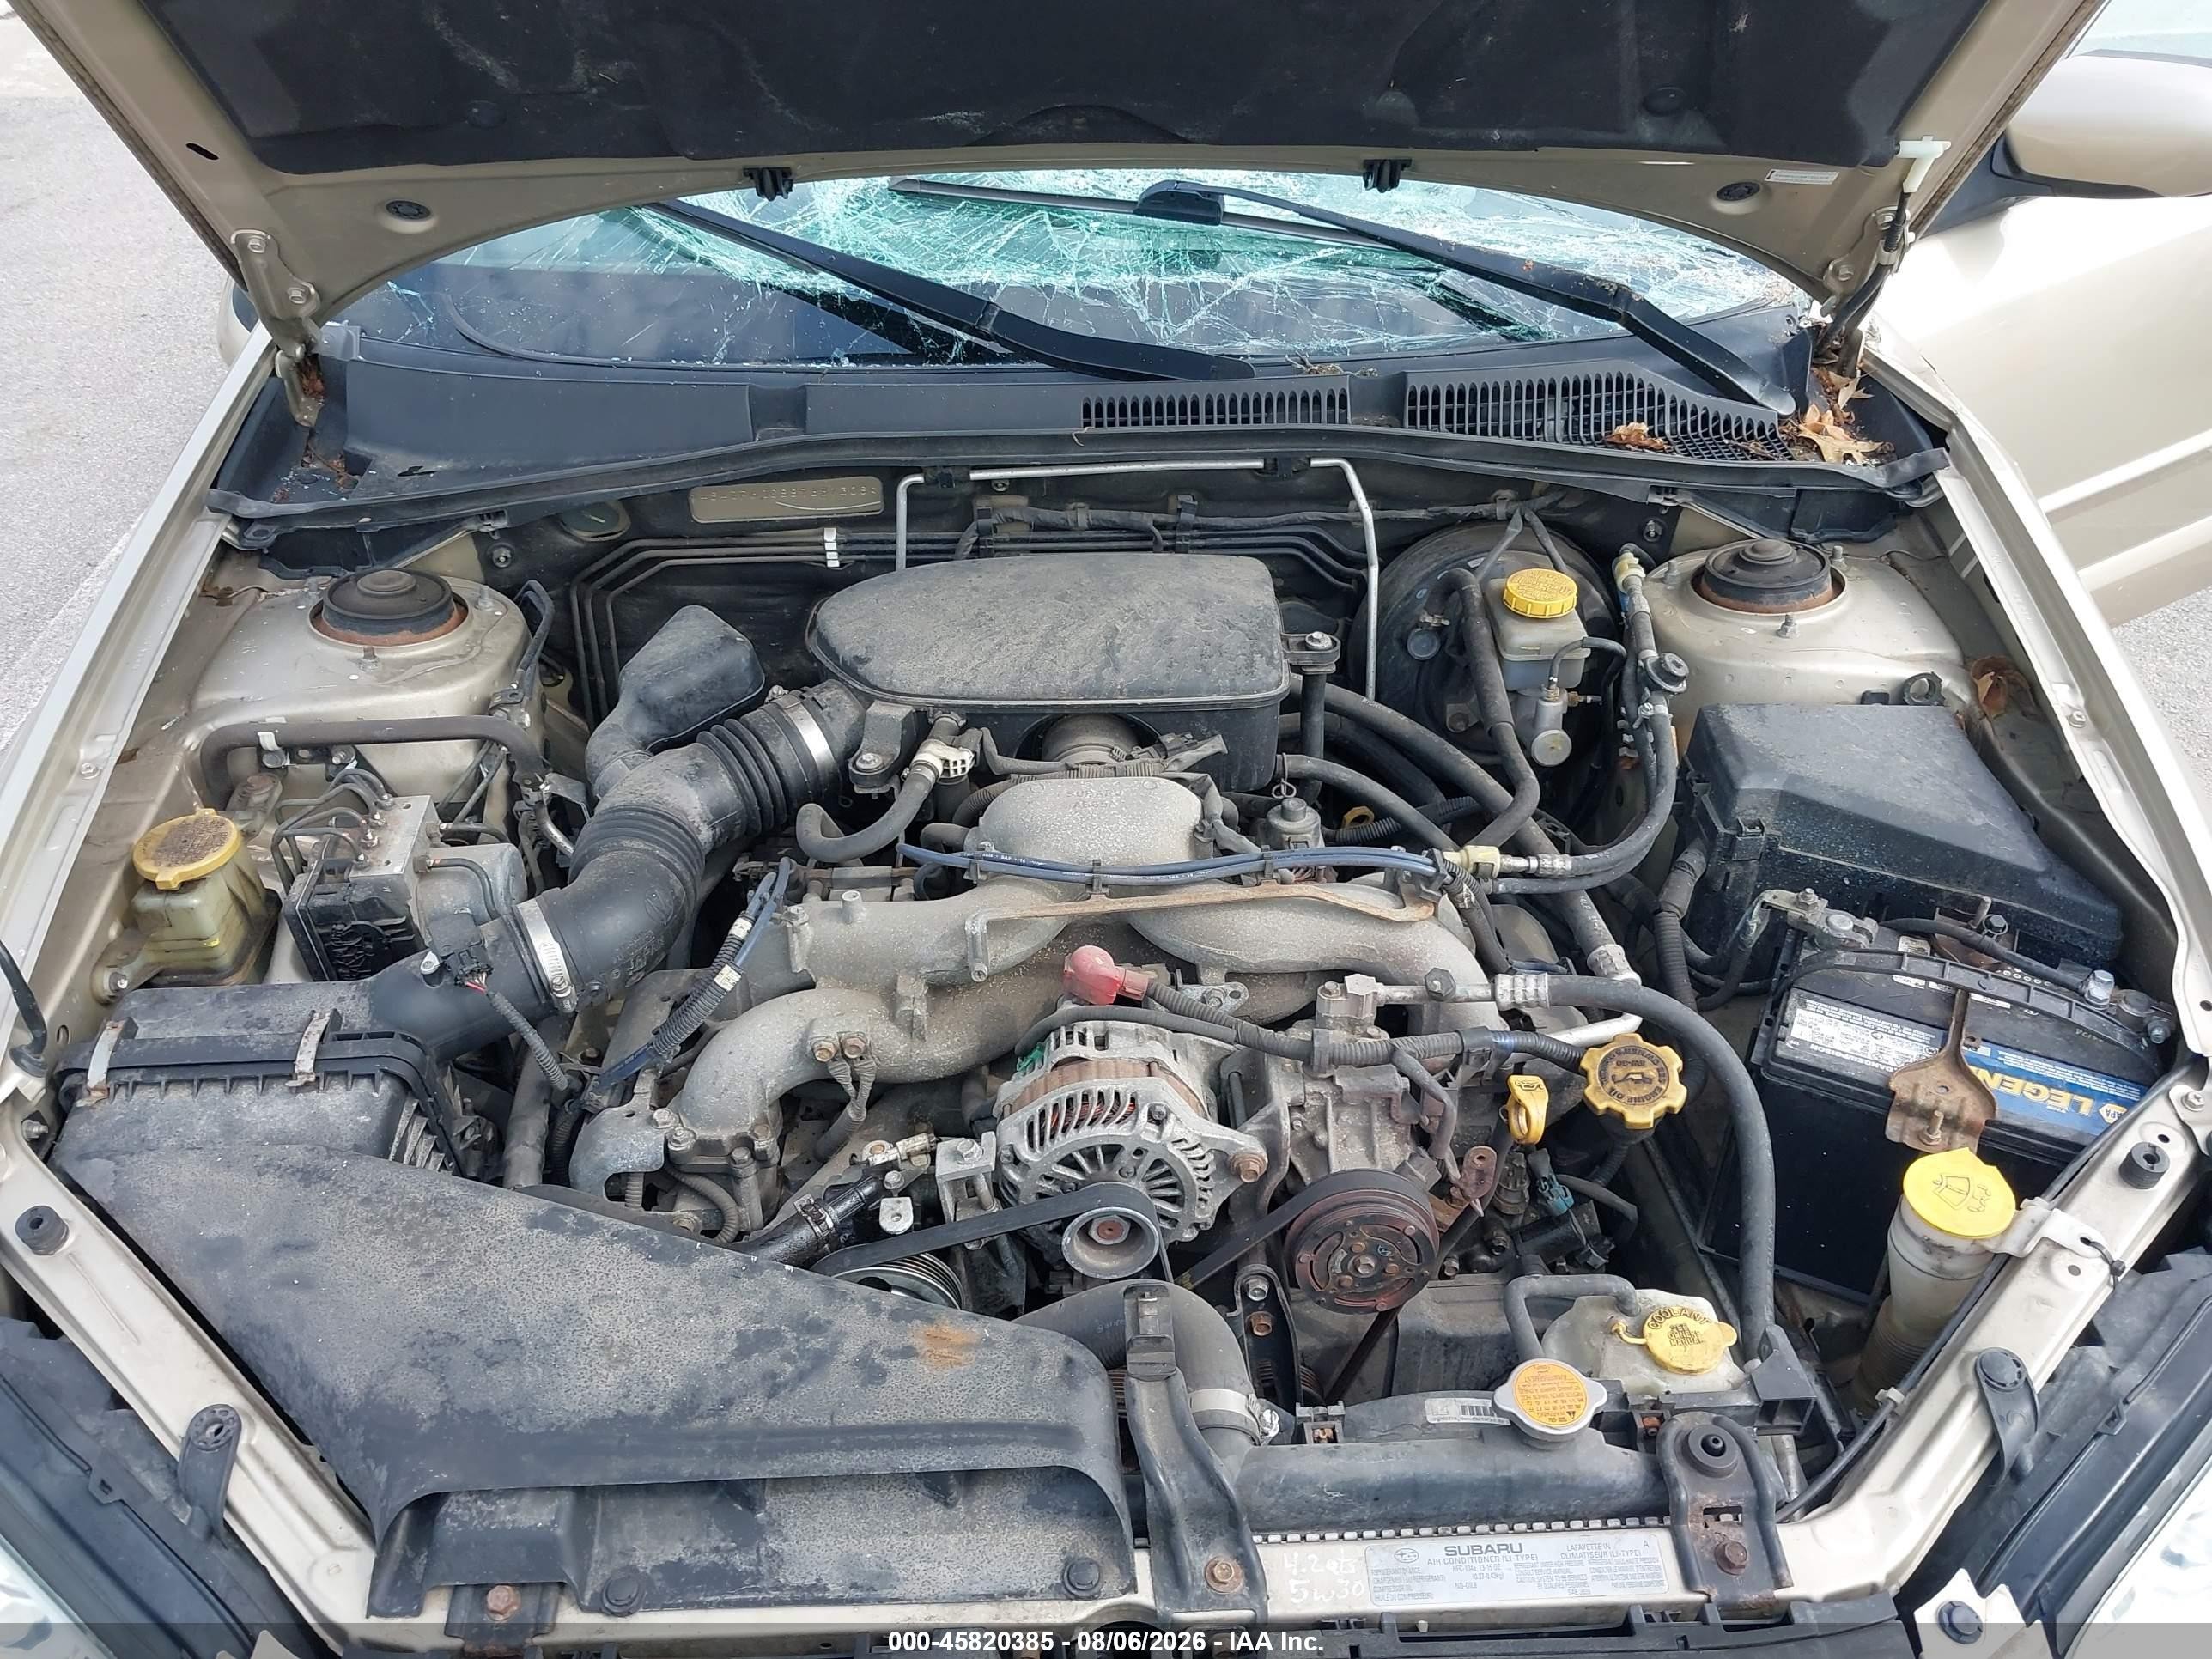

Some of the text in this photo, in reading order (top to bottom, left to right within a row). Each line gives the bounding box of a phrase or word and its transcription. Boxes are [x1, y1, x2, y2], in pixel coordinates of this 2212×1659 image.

[1607, 1085, 1663, 1104] ENGINE OIL
[1967, 1066, 2096, 1117] LEGEN
[1647, 1307, 1711, 1330] COOLANT
[1444, 1542, 1523, 1556] SUBARU
[1566, 1542, 1602, 1552] LAFAYETTE
[1643, 1540, 1650, 1548] A
[1427, 1558, 1442, 1566] AIR
[1443, 1555, 1501, 1565] CONDITIONER
[1559, 1550, 1608, 1560] CLIMATISEUR
